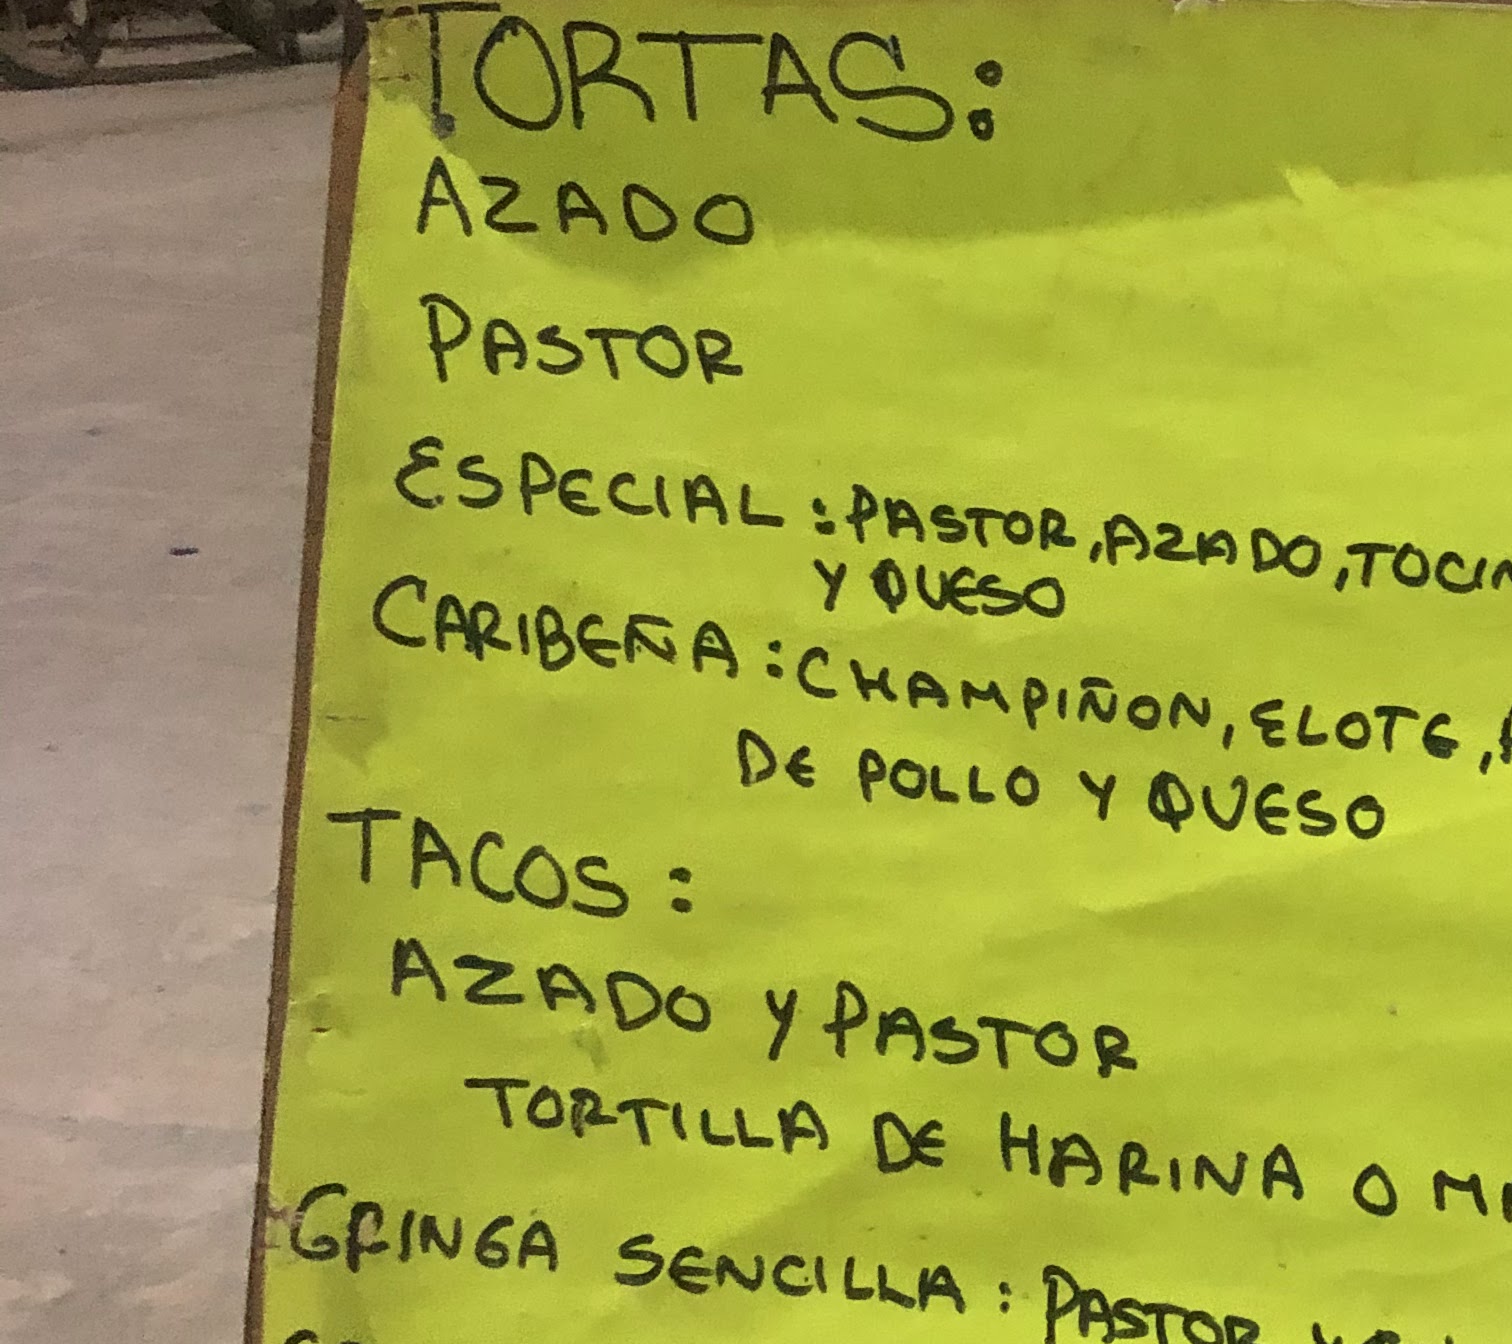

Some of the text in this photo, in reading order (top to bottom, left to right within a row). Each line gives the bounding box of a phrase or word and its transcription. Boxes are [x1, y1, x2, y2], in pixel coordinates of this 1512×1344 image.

[366, 1, 1003, 142] TORTAS:
[417, 156, 754, 245] AZADO
[420, 293, 743, 384] PASTOR
[814, 558, 1065, 618] Y QUESO
[737, 729, 1385, 840] DE POLLO Y QUESO
[326, 808, 691, 917] TACOS:
[392, 938, 1137, 1078] AZADO Y PASTOR
[464, 1078, 828, 1153] TORTILLA
[874, 1112, 945, 1174] DE
[1000, 1112, 1304, 1200] HARINA
[1353, 1164, 1397, 1216] O
